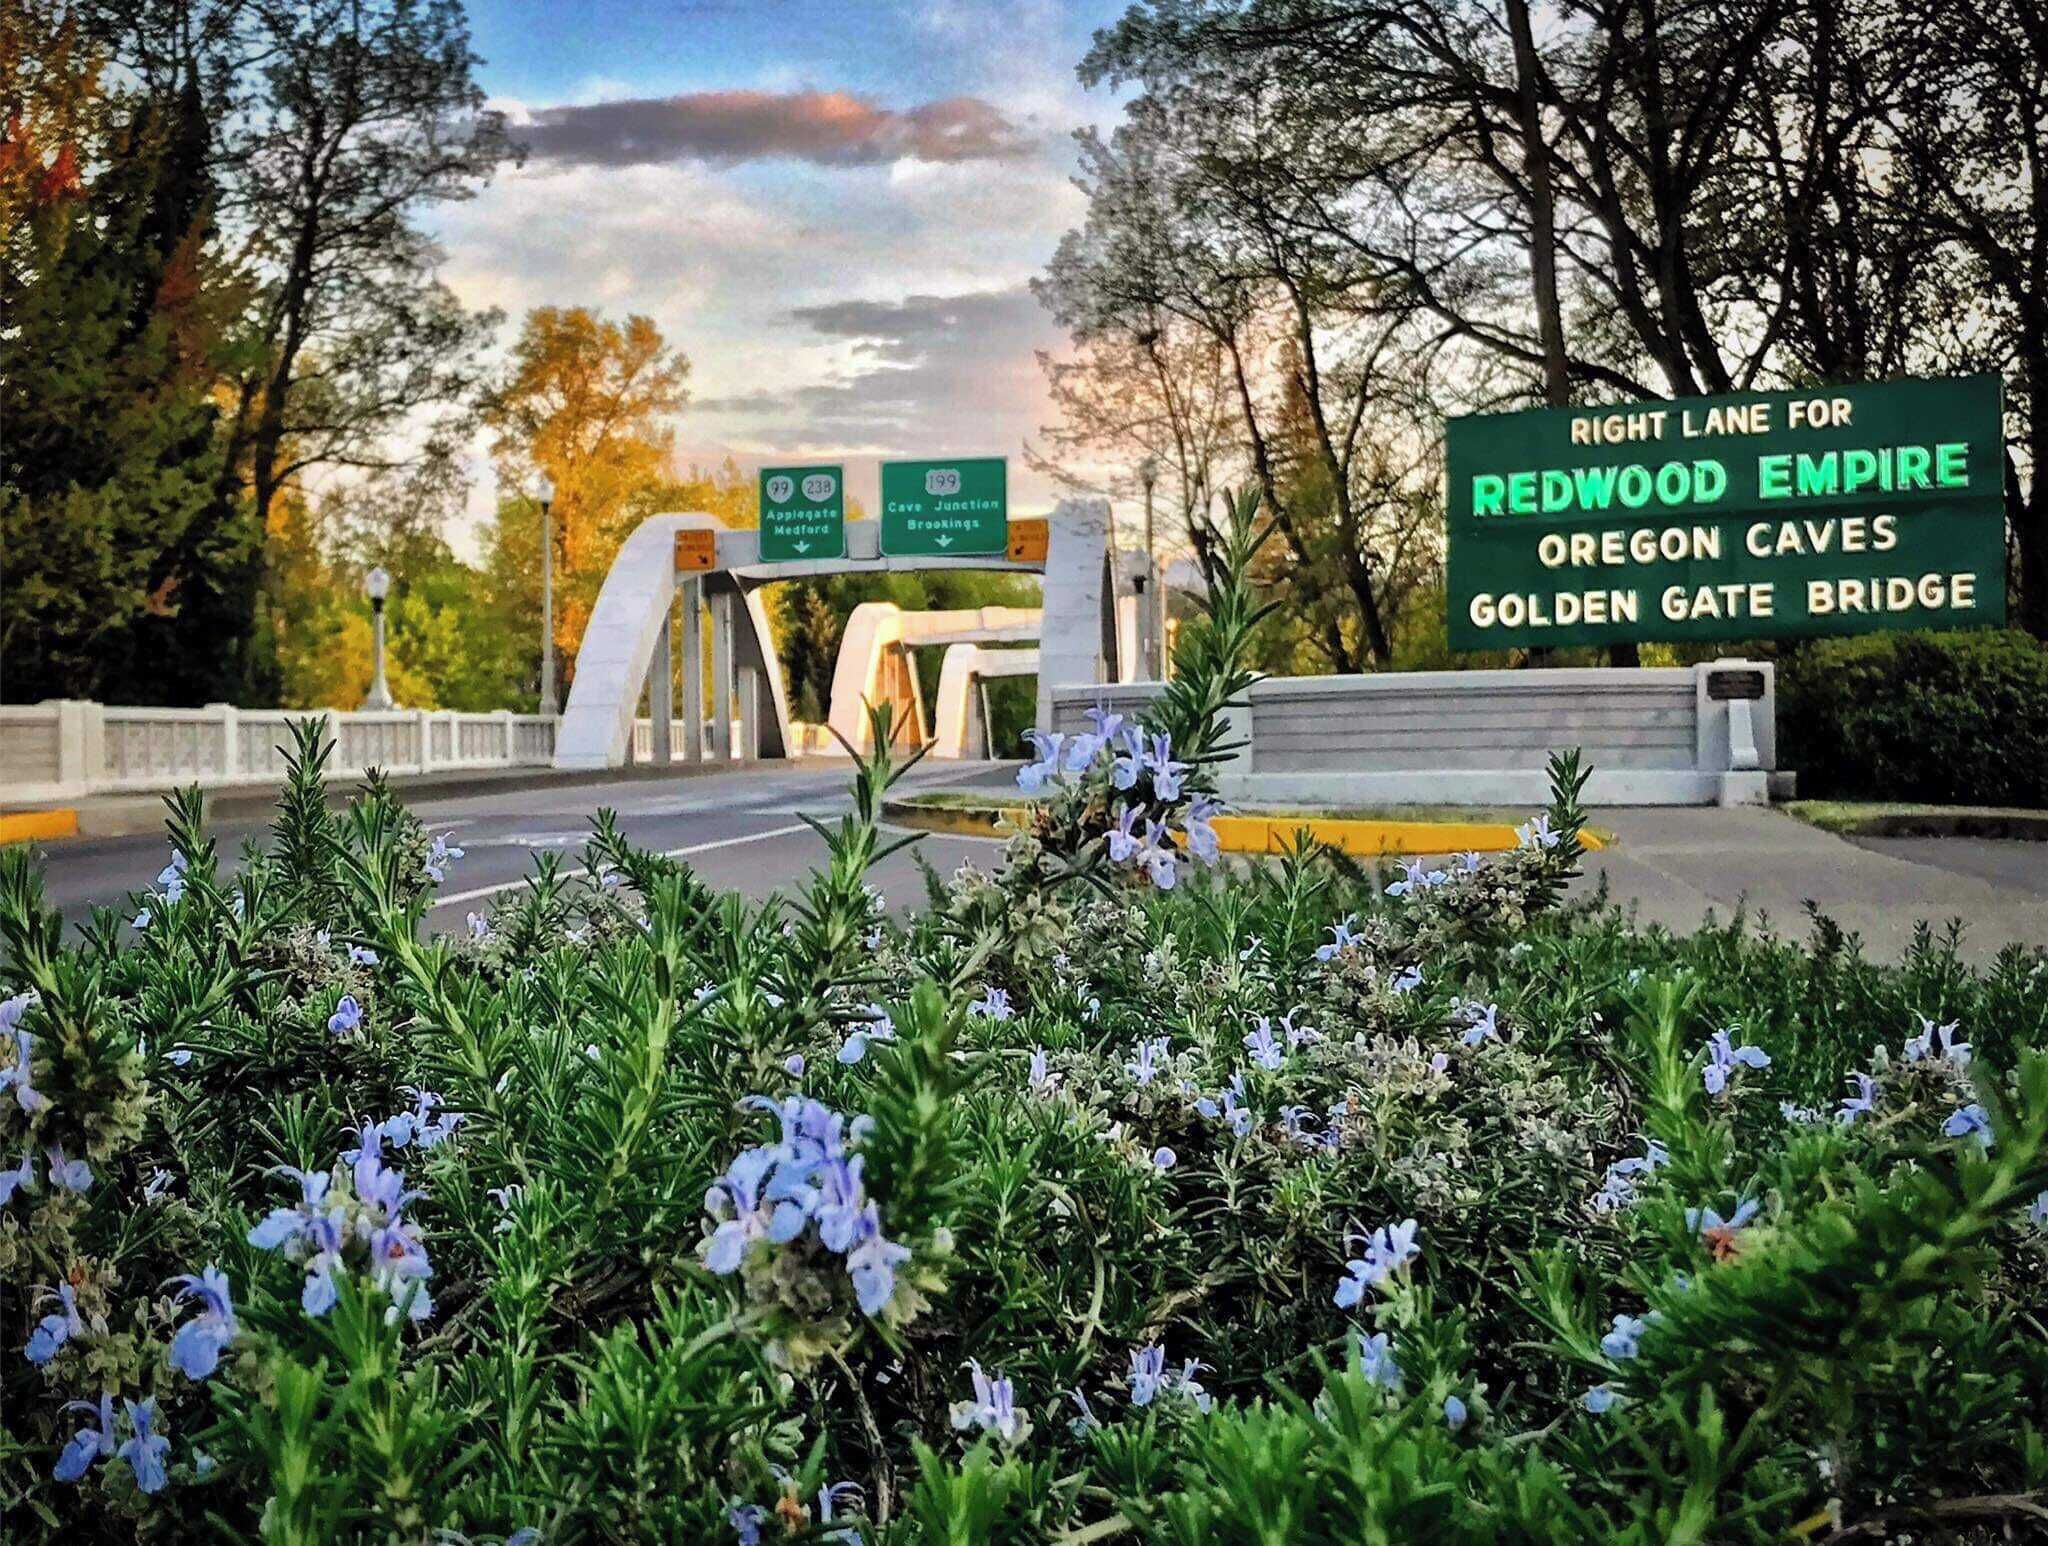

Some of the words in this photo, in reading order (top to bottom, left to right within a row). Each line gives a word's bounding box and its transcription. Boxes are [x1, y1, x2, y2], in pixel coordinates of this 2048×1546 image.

[1571, 411, 1666, 446] RIGHT
[1682, 403, 1771, 438] LANE
[1788, 399, 1853, 430] FOR
[807, 479, 832, 495] 238
[929, 474, 957, 489] 199
[1472, 459, 1727, 517] REDWOOD
[1758, 442, 1969, 500] EMPIRE
[771, 480, 789, 496] 99
[887, 501, 922, 513] Cave
[934, 499, 999, 511] Junction
[766, 508, 837, 522] Applegate
[774, 524, 829, 536] Medford
[907, 517, 980, 531] Brookings
[1538, 526, 1722, 568] OREGON
[1746, 515, 1898, 558] CAVES
[1469, 589, 1639, 628] GOLDEN
[1661, 582, 1775, 621] GATE
[1807, 573, 1977, 616] BRIDGE
